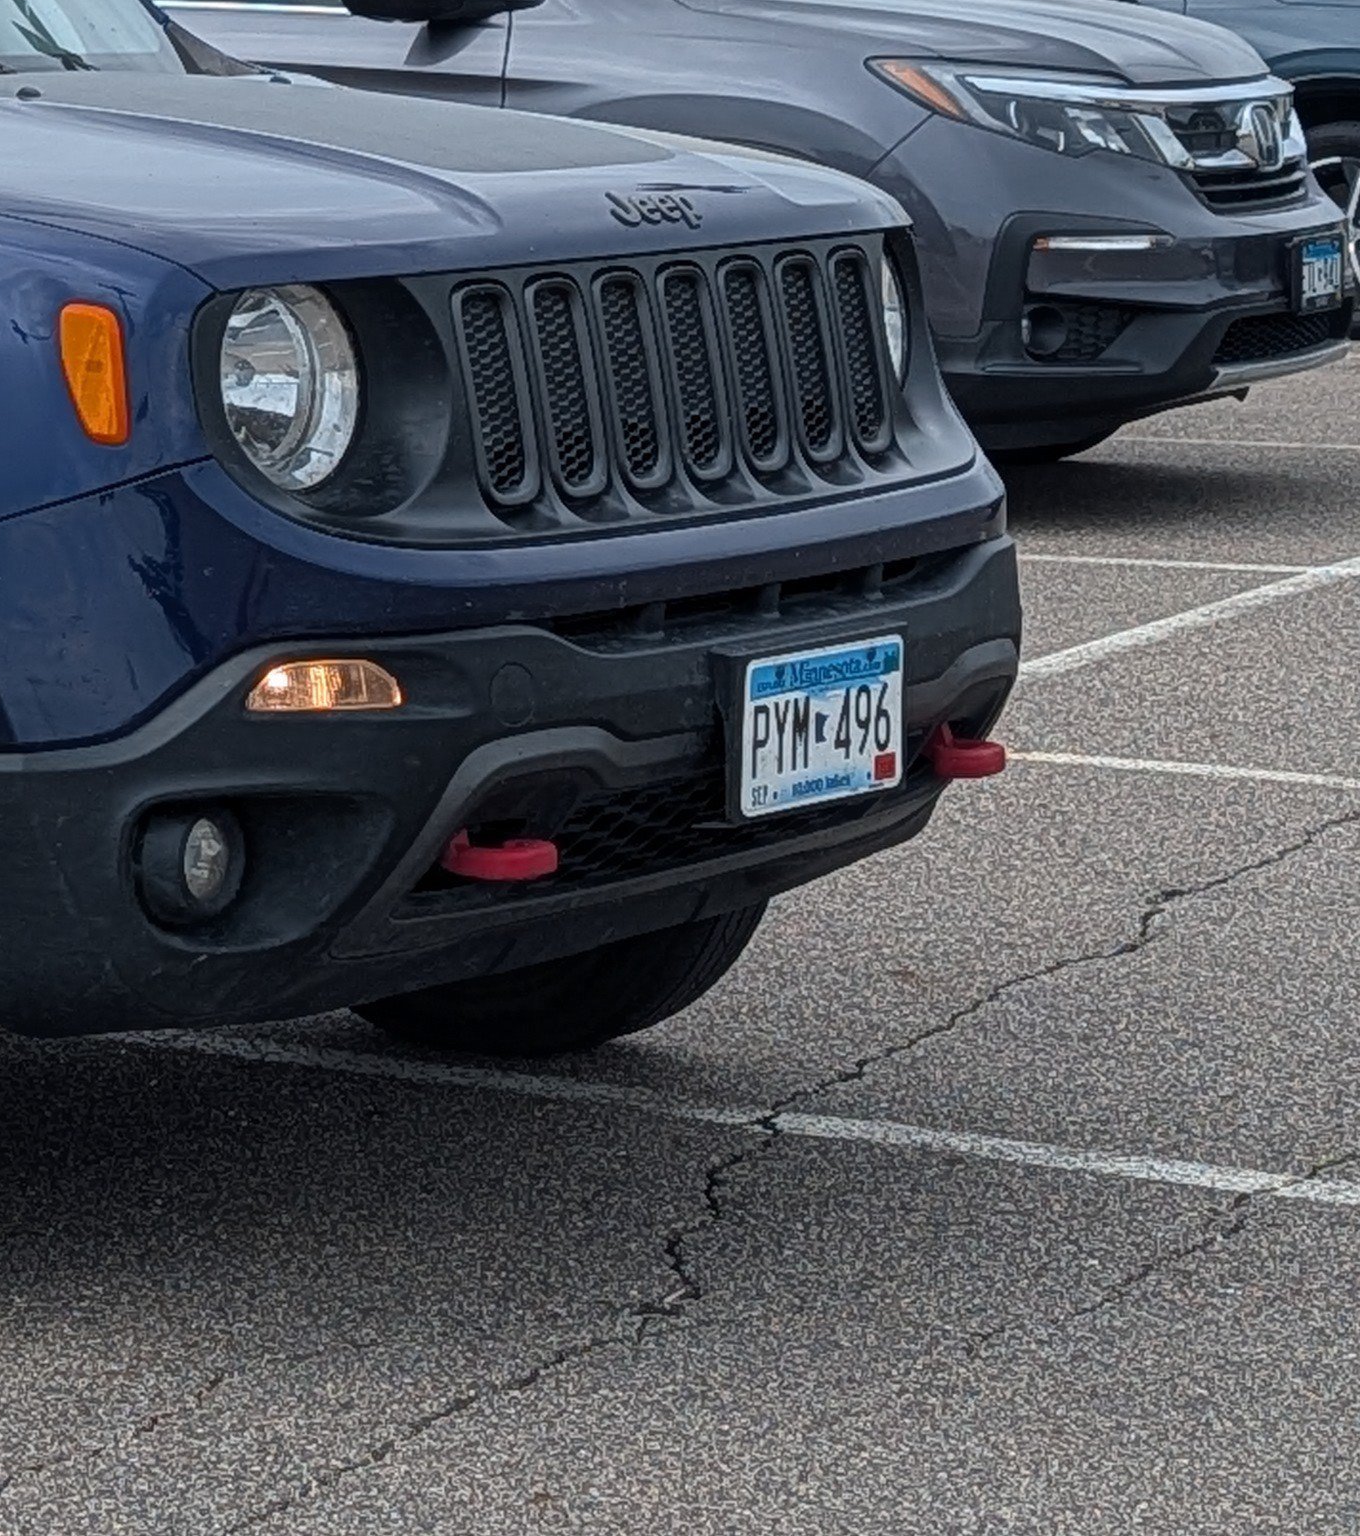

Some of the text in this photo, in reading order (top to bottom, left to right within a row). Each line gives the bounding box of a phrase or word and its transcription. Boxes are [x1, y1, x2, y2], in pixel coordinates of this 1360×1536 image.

[604, 191, 703, 230] Jeep
[752, 681, 891, 780] PYM 496
